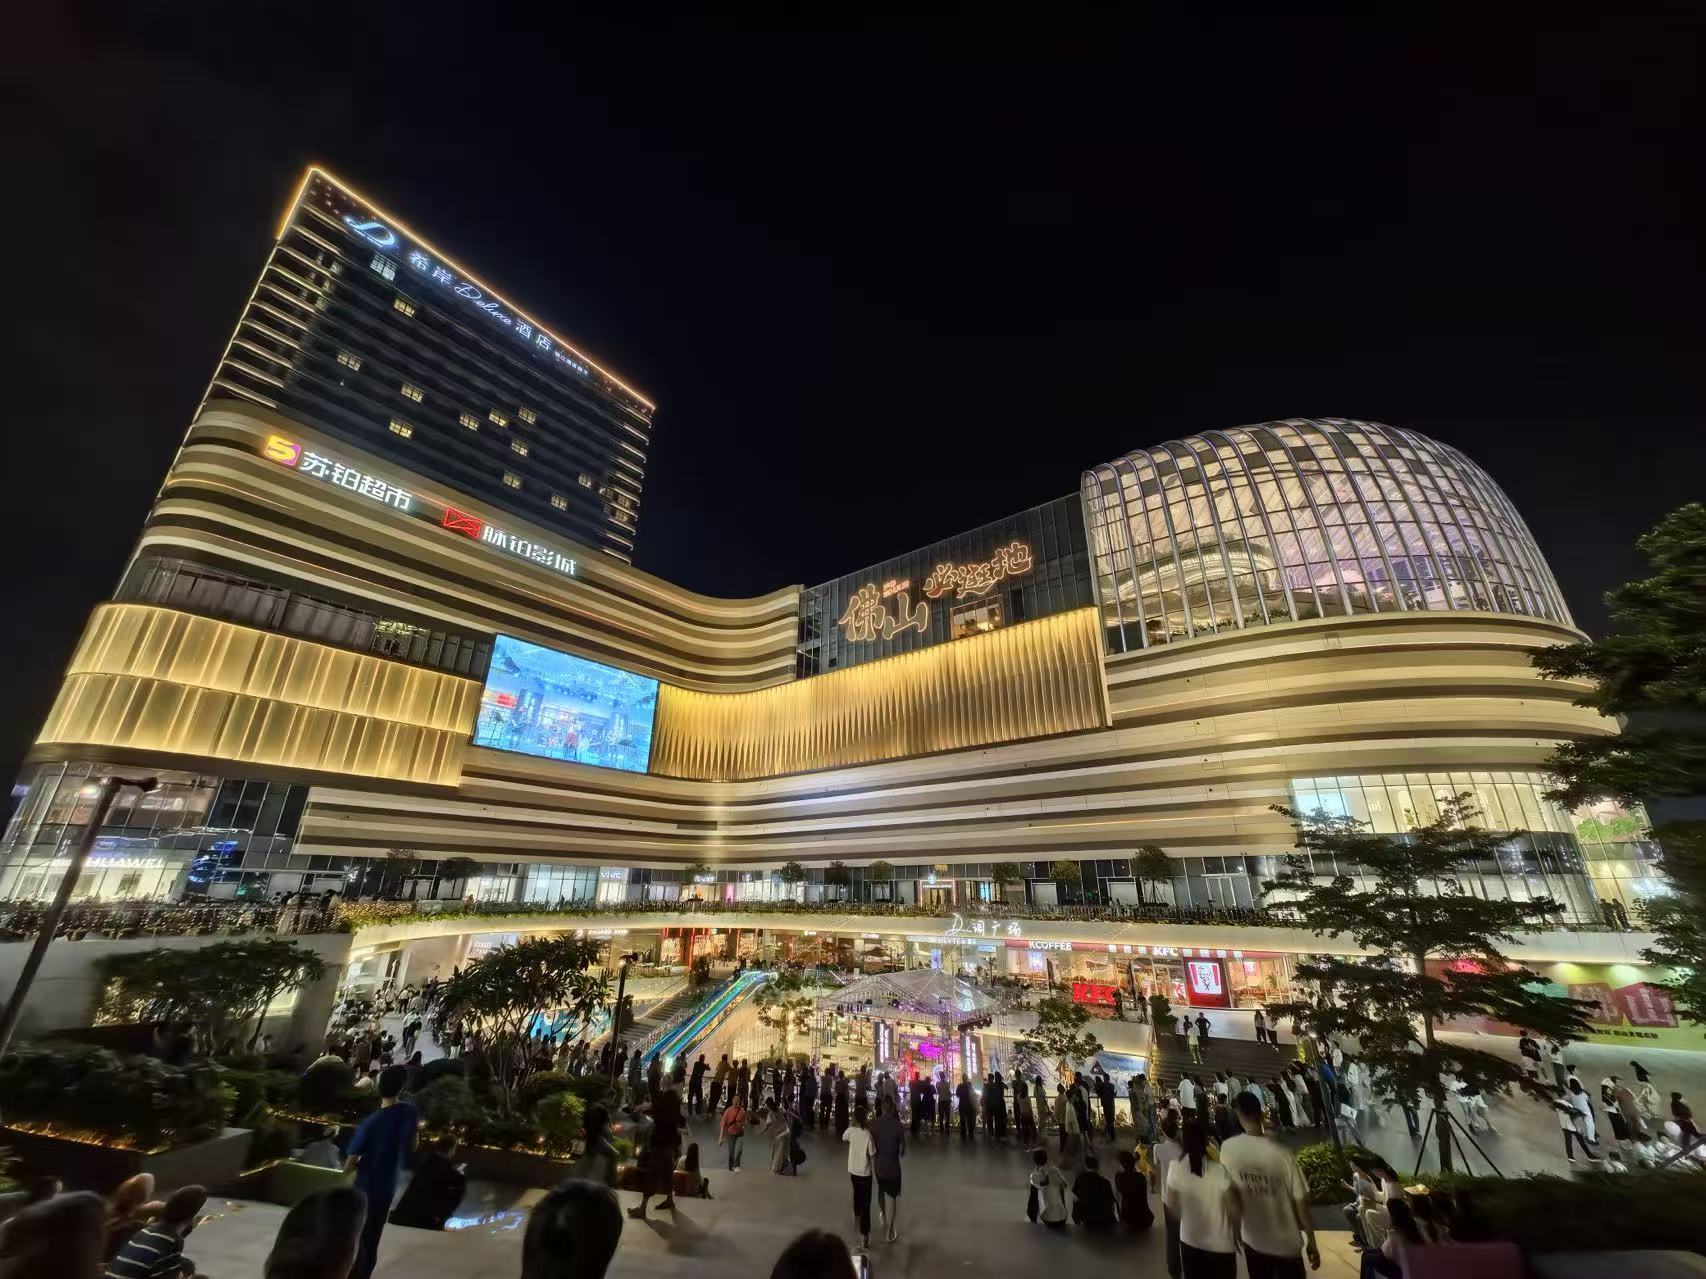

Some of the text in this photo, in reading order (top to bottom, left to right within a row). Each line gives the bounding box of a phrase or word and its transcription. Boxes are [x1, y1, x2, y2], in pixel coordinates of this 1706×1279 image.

[409, 252, 552, 350] 希岸 Deluxe 酒店
[300, 451, 412, 510] 苏铂超市
[483, 526, 576, 575] 脉铂影城
[839, 584, 928, 641] 佛山
[85, 857, 165, 868] HUAWEI
[1029, 941, 1072, 951] KCOFFEE
[1152, 947, 1178, 957] KFC
